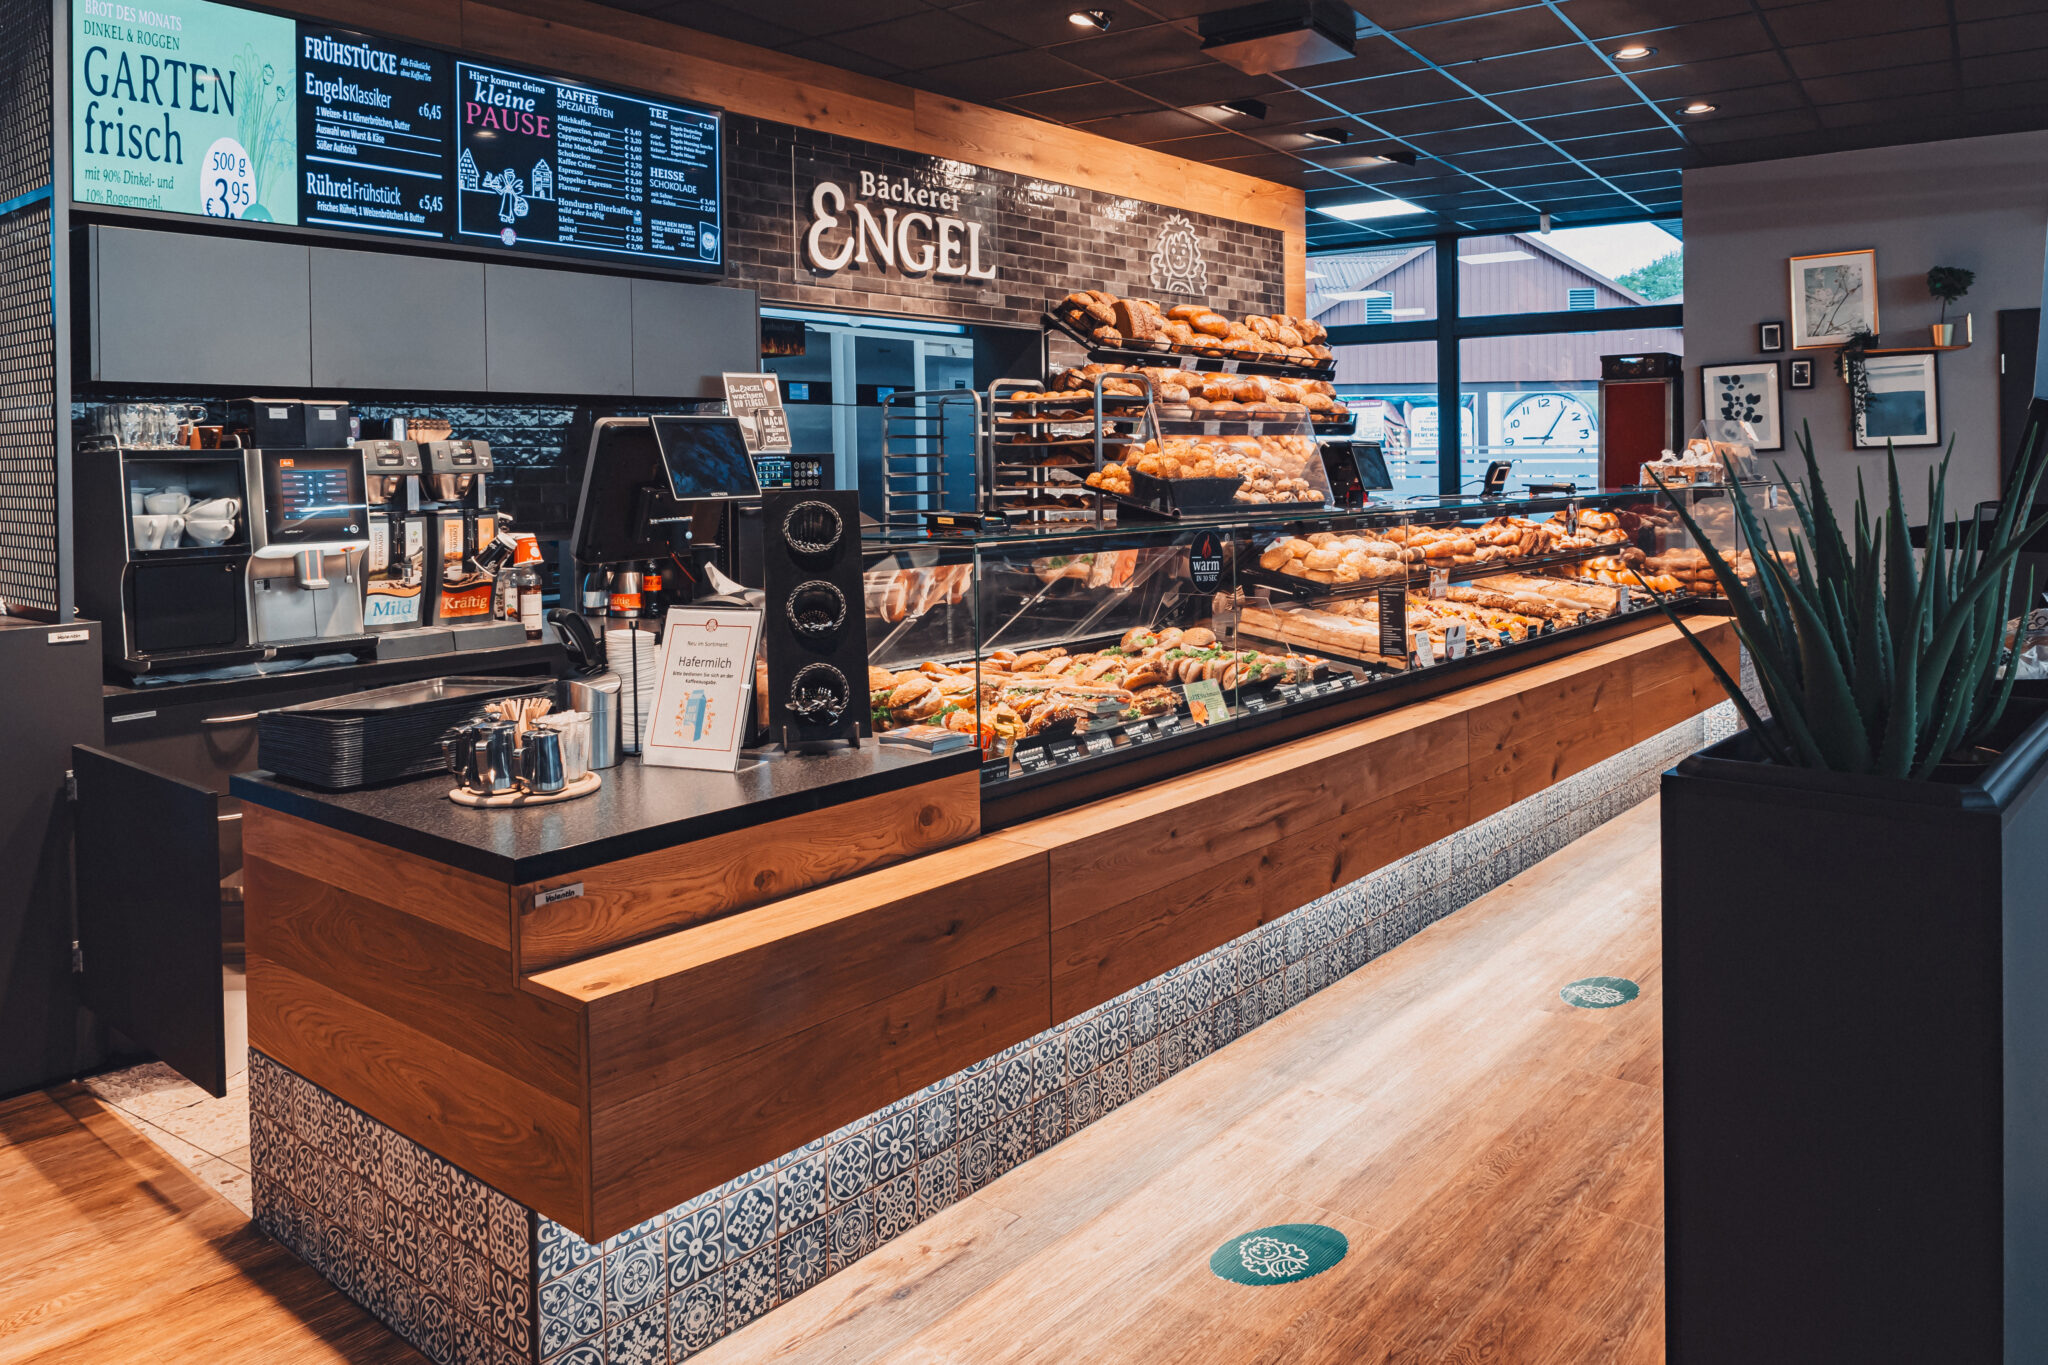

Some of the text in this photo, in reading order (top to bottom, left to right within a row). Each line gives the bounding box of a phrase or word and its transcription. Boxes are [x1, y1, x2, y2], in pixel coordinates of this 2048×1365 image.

[85, 0, 182, 31] BROT DES MONATS
[84, 20, 180, 51] DINKEL & ROGGEN
[304, 35, 398, 76] FRÜHSTÜCKE
[400, 57, 409, 67] Alle
[84, 46, 236, 117] GARTEN
[469, 70, 546, 95] Hier kommt deine
[475, 81, 535, 112] kleine
[556, 87, 599, 106] KAFFEE
[556, 99, 614, 119] SPEZIALITÄTEN
[649, 107, 669, 120] TEE
[394, 119, 411, 131] Butter
[466, 101, 551, 139] PAUSE
[557, 115, 592, 127] Milchkaffee
[85, 101, 183, 165] frisch
[316, 123, 339, 137] Auswahl
[340, 128, 350, 138] von
[350, 129, 366, 141] Wurst
[372, 132, 385, 144] Käse
[557, 123, 593, 137] Cappuccino,
[557, 132, 593, 145] Cappuccino,
[333, 142, 357, 155] Aufstrich
[557, 140, 573, 149] Latte
[573, 143, 604, 154] Macchiato
[213, 152, 246, 177] 500 g
[557, 157, 577, 166] Kaffee
[557, 165, 583, 176] Espresso
[649, 166, 685, 182] HEISSE
[85, 167, 174, 190] mit 90% Dinkel- und
[558, 174, 587, 185] Doppelter
[587, 179, 612, 189] Espresso
[558, 183, 581, 193] Flavour
[649, 178, 697, 194] SCHOKOLADE
[860, 170, 959, 212] Bäckerei
[86, 188, 103, 203] 10%
[558, 197, 634, 216] Honduras Filterkaffee
[558, 207, 572, 215] mild
[558, 216, 575, 224] klein
[558, 225, 578, 234] mittel
[808, 181, 996, 280] ENGEL
[1537, 398, 1550, 408] 12
[1522, 406, 1530, 415] 11
[1571, 411, 1582, 421] 2
[763, 416, 783, 426] MACH
[1510, 419, 1520, 429] 10
[1579, 428, 1590, 439] 3
[1504, 437, 1515, 446] 9
[1192, 560, 1220, 571] warm
[373, 600, 412, 617] Mild
[443, 595, 488, 610] Kräftig
[678, 656, 732, 669] Hafermilch
[545, 889, 575, 902] Valentin
